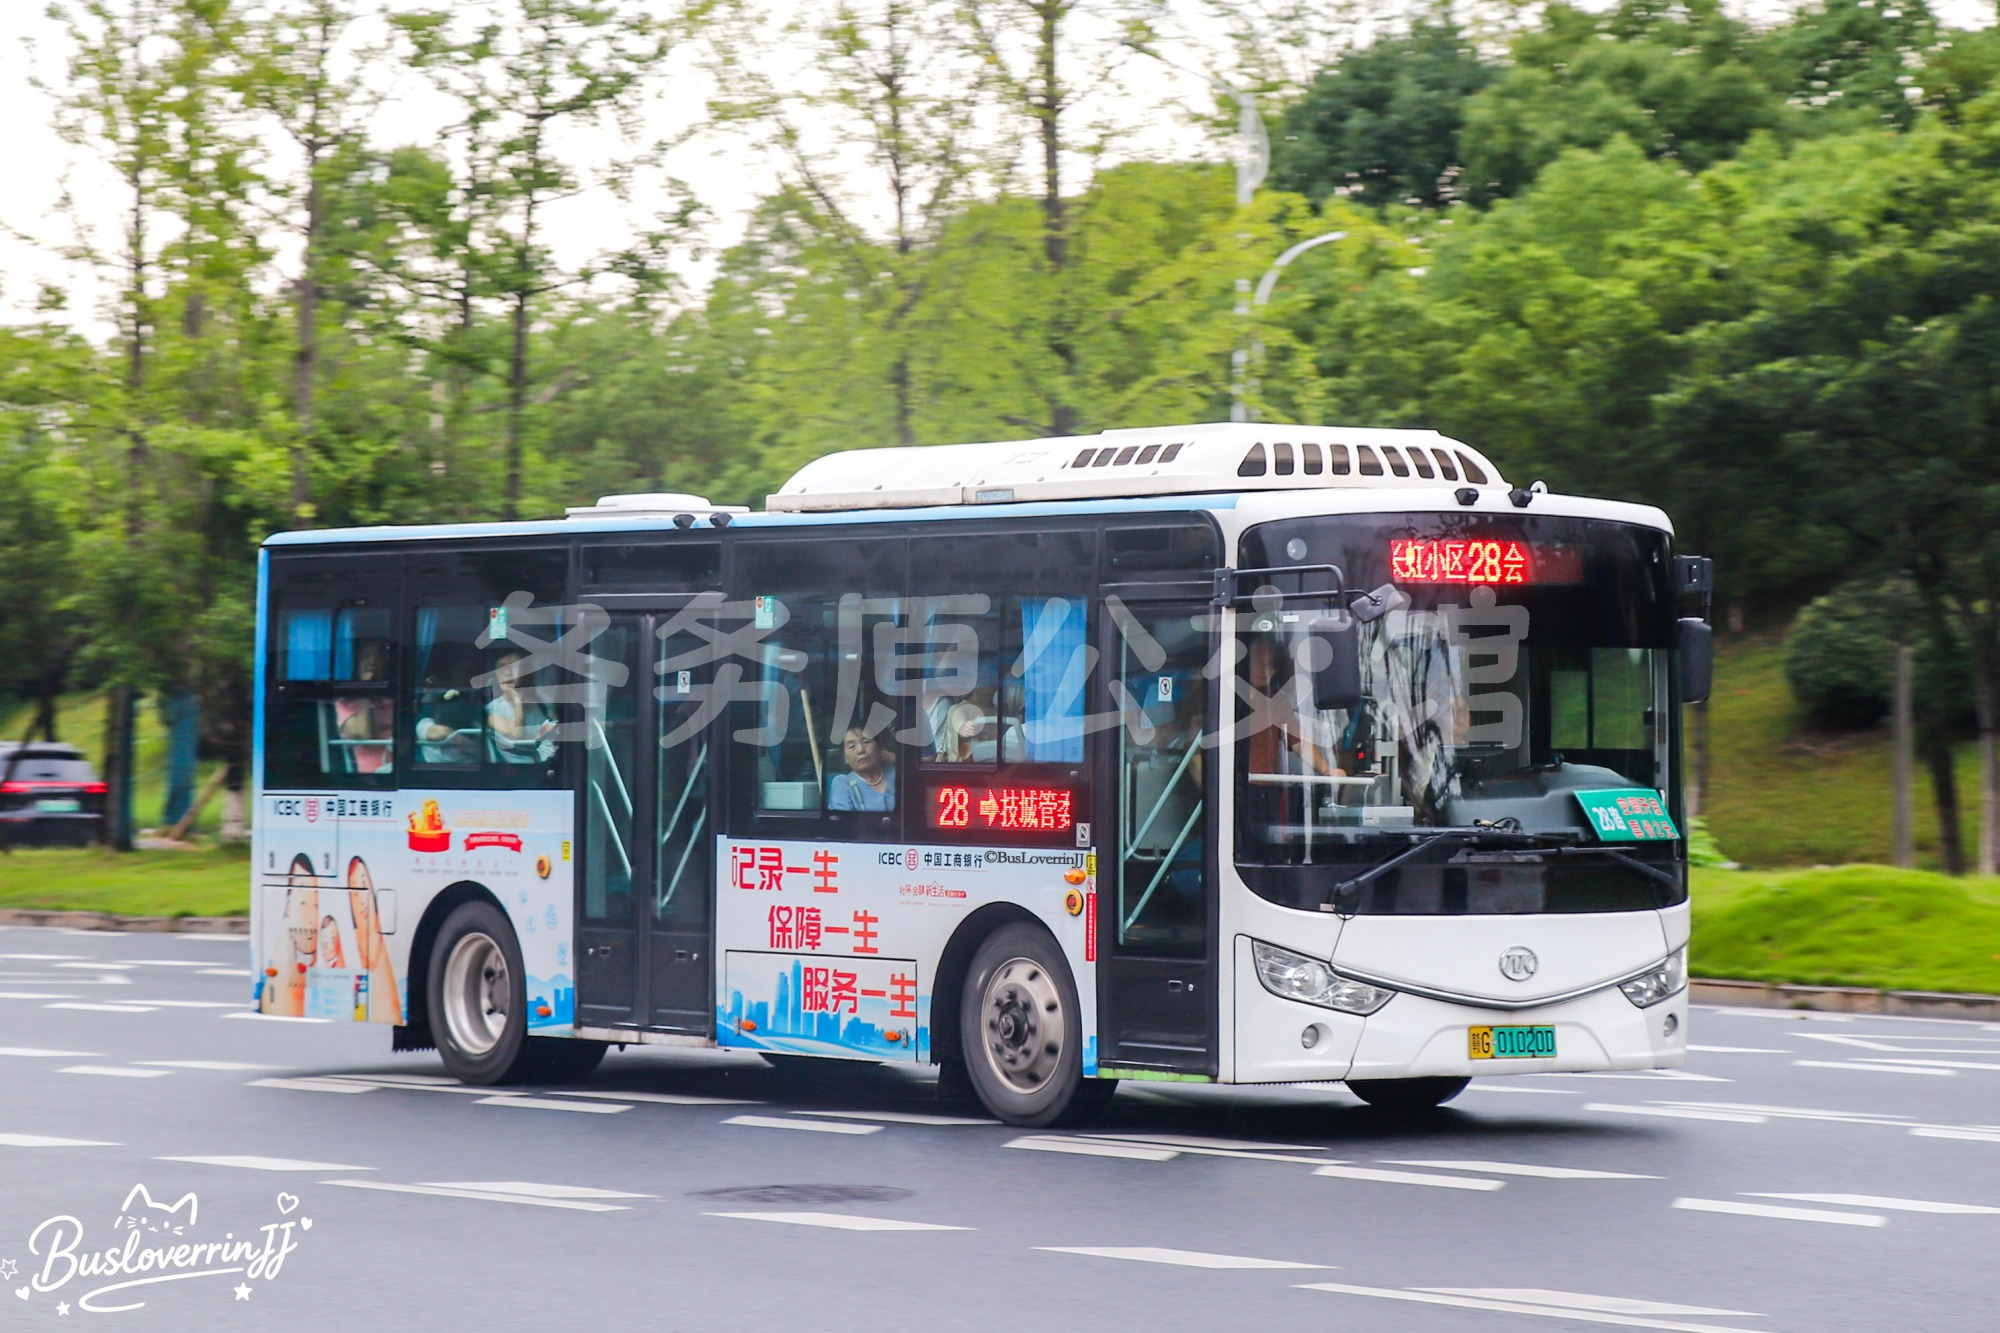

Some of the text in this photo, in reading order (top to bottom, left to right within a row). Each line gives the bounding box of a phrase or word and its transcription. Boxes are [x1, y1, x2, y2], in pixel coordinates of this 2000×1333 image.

[273, 799, 301, 816] ICBC
[938, 787, 969, 827] 28
[731, 846, 839, 893] 记录一生
[878, 851, 983, 869] ICBC 中国工商银行
[767, 905, 879, 954] 保障一生
[803, 967, 917, 1018] 服务一生
